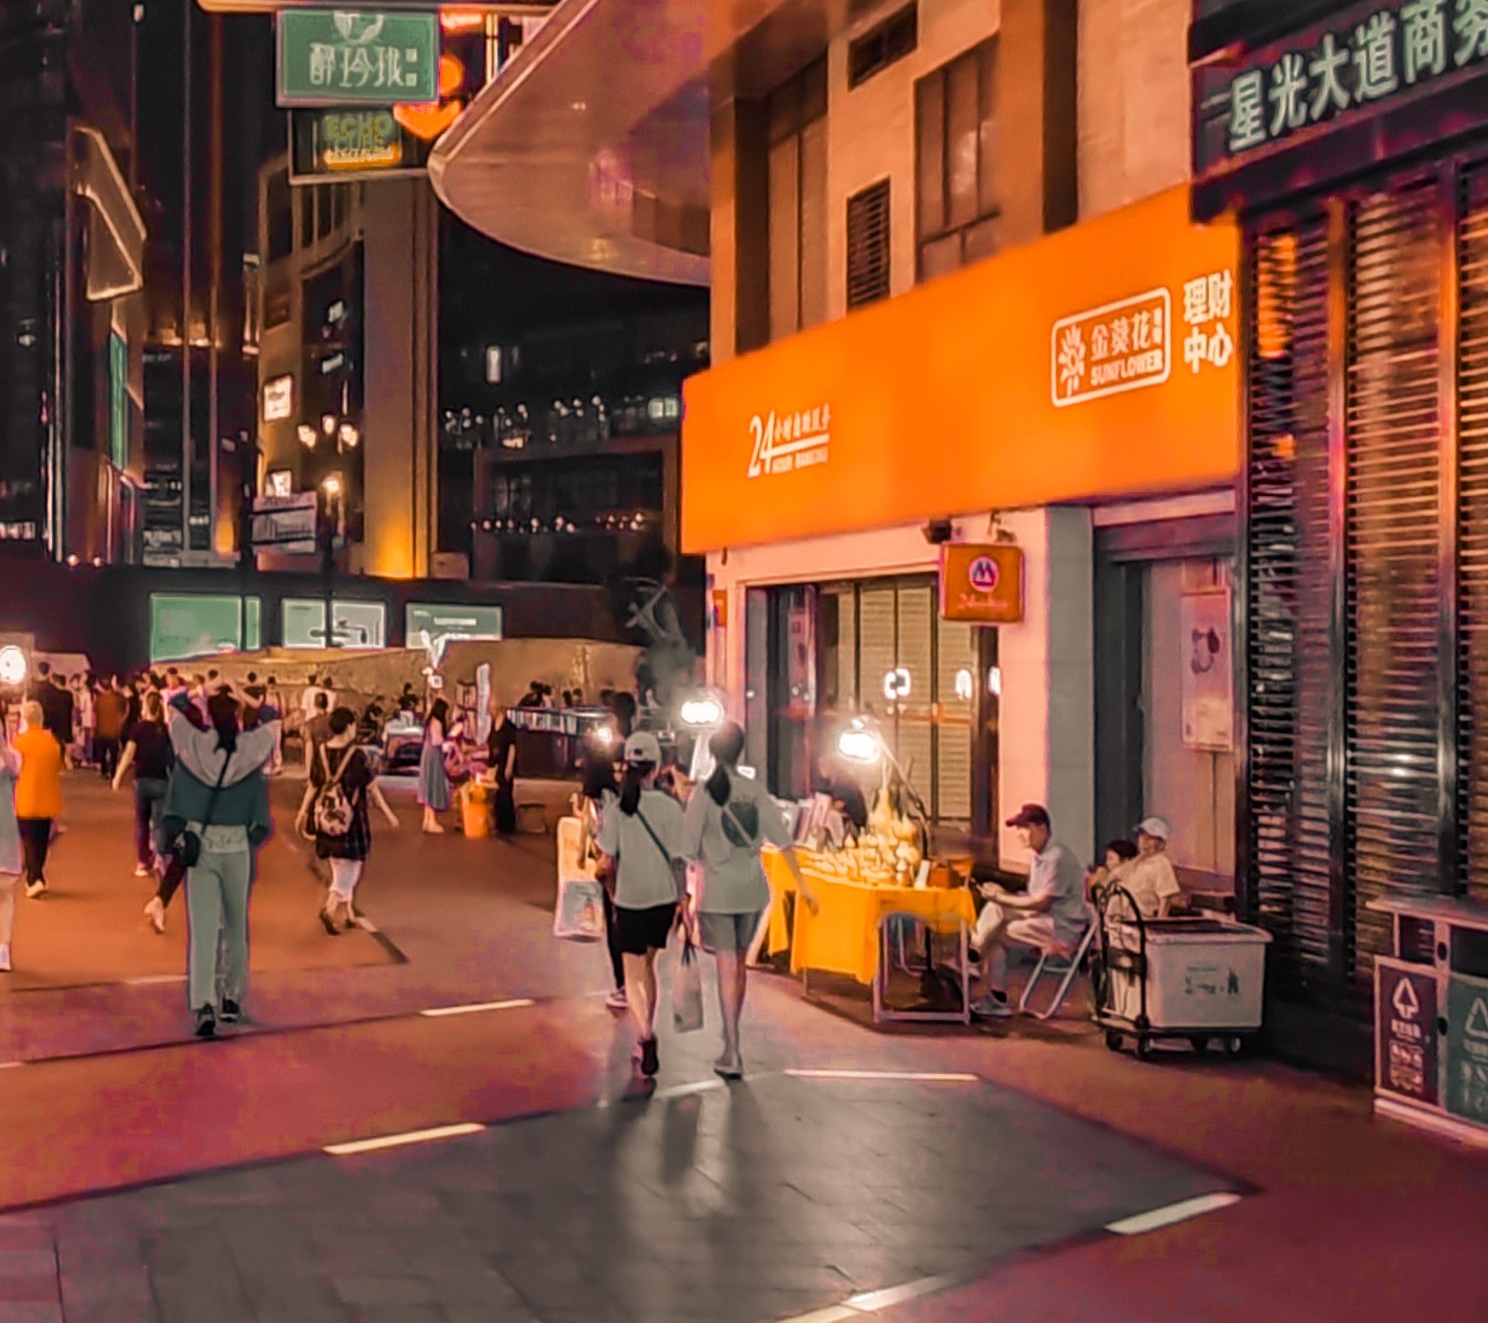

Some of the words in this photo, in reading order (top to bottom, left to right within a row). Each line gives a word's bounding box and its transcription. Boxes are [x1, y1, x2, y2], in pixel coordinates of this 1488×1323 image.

[1183, 268, 1233, 325] 理财
[1089, 310, 1153, 361] 金葵花
[1183, 322, 1233, 375] 中心
[1090, 348, 1163, 387] SUNFLOWER
[747, 410, 775, 478] 24
